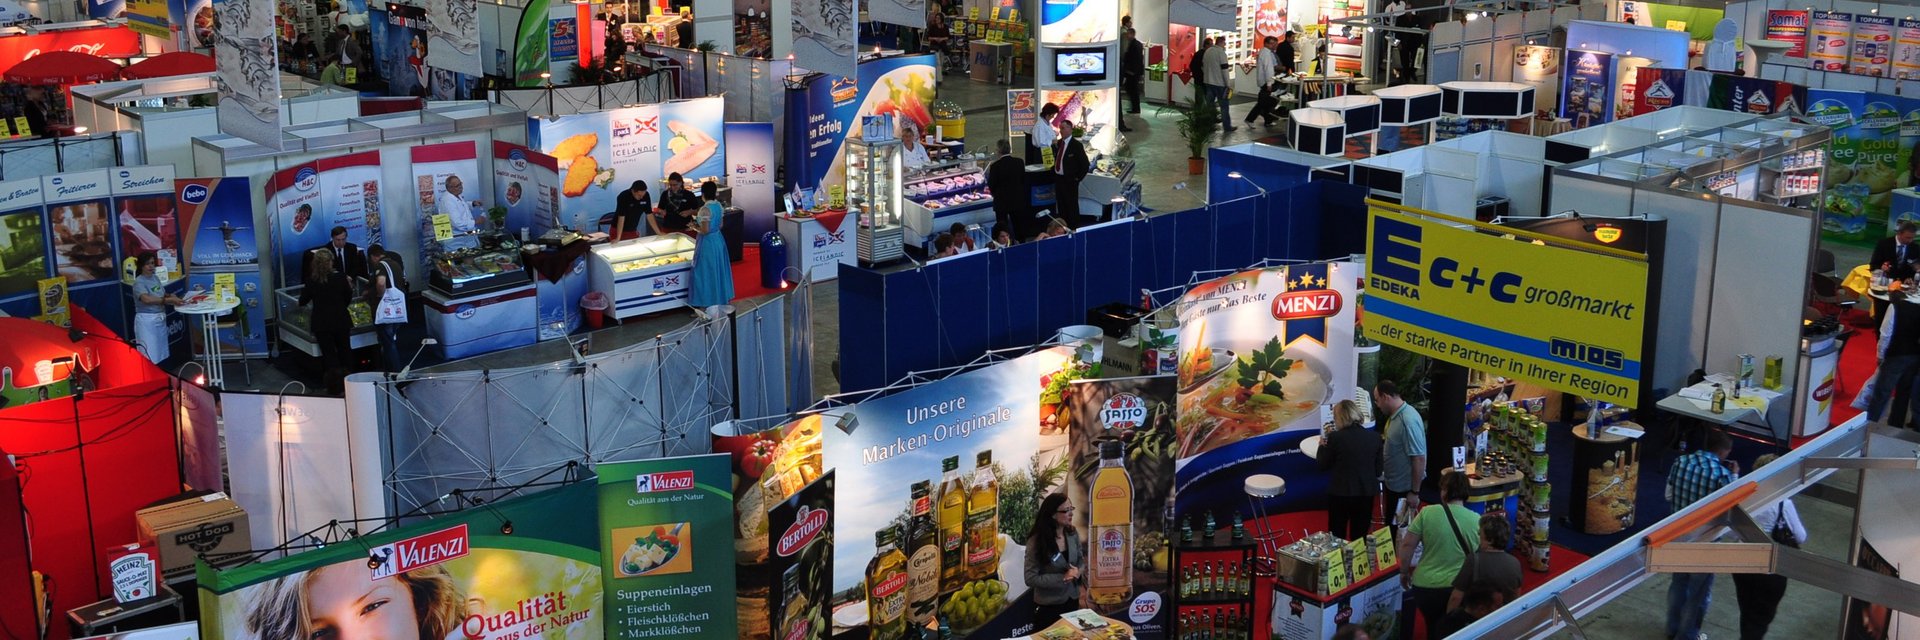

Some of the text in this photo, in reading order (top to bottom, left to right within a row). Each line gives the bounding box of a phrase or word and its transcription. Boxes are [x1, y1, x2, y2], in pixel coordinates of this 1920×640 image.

[1771, 12, 1806, 26] Somat
[819, 119, 842, 136] Erfolg
[613, 145, 657, 157] ICELANDIC
[1862, 136, 1896, 150] Gold
[56, 181, 96, 198] Fritieren
[122, 176, 165, 190] Streichen
[302, 178, 314, 188] H&C
[16, 187, 39, 200] Braten
[186, 188, 206, 199] bebo
[280, 199, 296, 209] Qualität
[305, 191, 319, 200] Vielfalt
[813, 252, 844, 262] ICELANDIC
[1372, 214, 1422, 286] E
[1202, 292, 1216, 300] von
[1371, 277, 1420, 300] EDEKA
[1206, 304, 1221, 314] nur
[1242, 293, 1267, 304] Beste
[1277, 294, 1335, 314] MENZI
[1524, 286, 1634, 320] großmarkt
[1405, 332, 1447, 354] starke
[1450, 344, 1506, 368] Partner
[1510, 358, 1523, 374] in
[1527, 363, 1566, 384] Ihrer
[1569, 374, 1629, 399] Region
[906, 396, 967, 426] Unsere
[1104, 407, 1142, 423] SASSO
[862, 406, 1012, 466] Marken-Originale
[653, 475, 691, 490] VALENZI
[628, 496, 656, 506] Qualität
[180, 526, 230, 542] HOT DOG
[782, 513, 823, 553] BERTOLLI
[398, 535, 464, 570] VALENZI
[116, 561, 140, 574] HEINZ
[617, 584, 712, 601] Suppeneinlagen
[876, 574, 907, 596] BERTOLLI
[627, 602, 671, 614] Eierstich
[888, 596, 905, 607] EXTRA
[1134, 605, 1156, 614] SOS
[462, 591, 566, 640] Qualität
[524, 622, 546, 637] der
[550, 608, 590, 629] Natur
[628, 612, 709, 627] Fleischklößchen
[628, 625, 701, 638] Markklößchen
[1012, 622, 1034, 638] Beste
